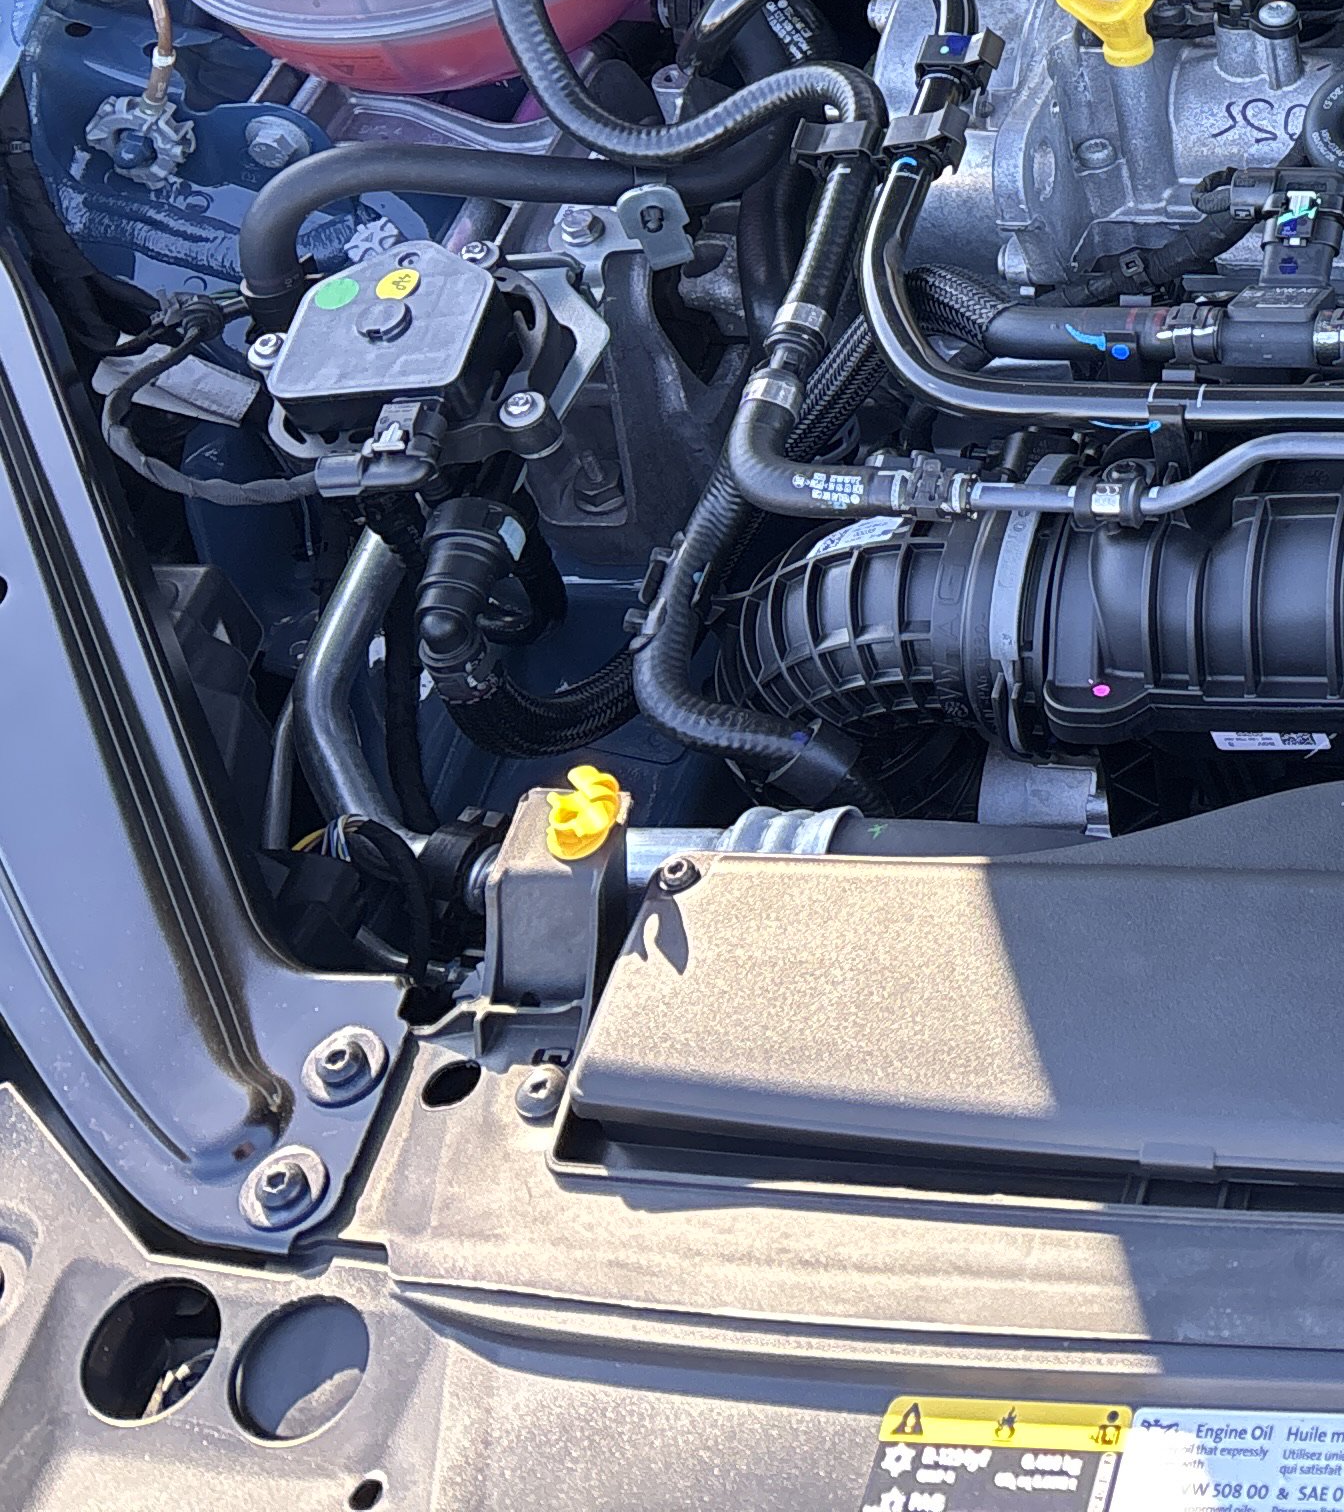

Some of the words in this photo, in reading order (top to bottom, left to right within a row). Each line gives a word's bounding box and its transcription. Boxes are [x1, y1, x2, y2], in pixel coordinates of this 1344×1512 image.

[1195, 1423, 1248, 1444] Engine
[1251, 1424, 1274, 1441] Oil
[1286, 1426, 1327, 1442] Huile
[1196, 1444, 1217, 1456] that
[1219, 1445, 1269, 1461] expressly
[1283, 1448, 1323, 1462] Utilisez
[1278, 1463, 1298, 1477] qui
[1299, 1463, 1342, 1477] satisfait
[1181, 1482, 1211, 1498] VW
[1211, 1483, 1243, 1499] 508
[1246, 1484, 1270, 1500] 00
[1276, 1487, 1290, 1501] &
[1297, 1485, 1330, 1502] SAE
